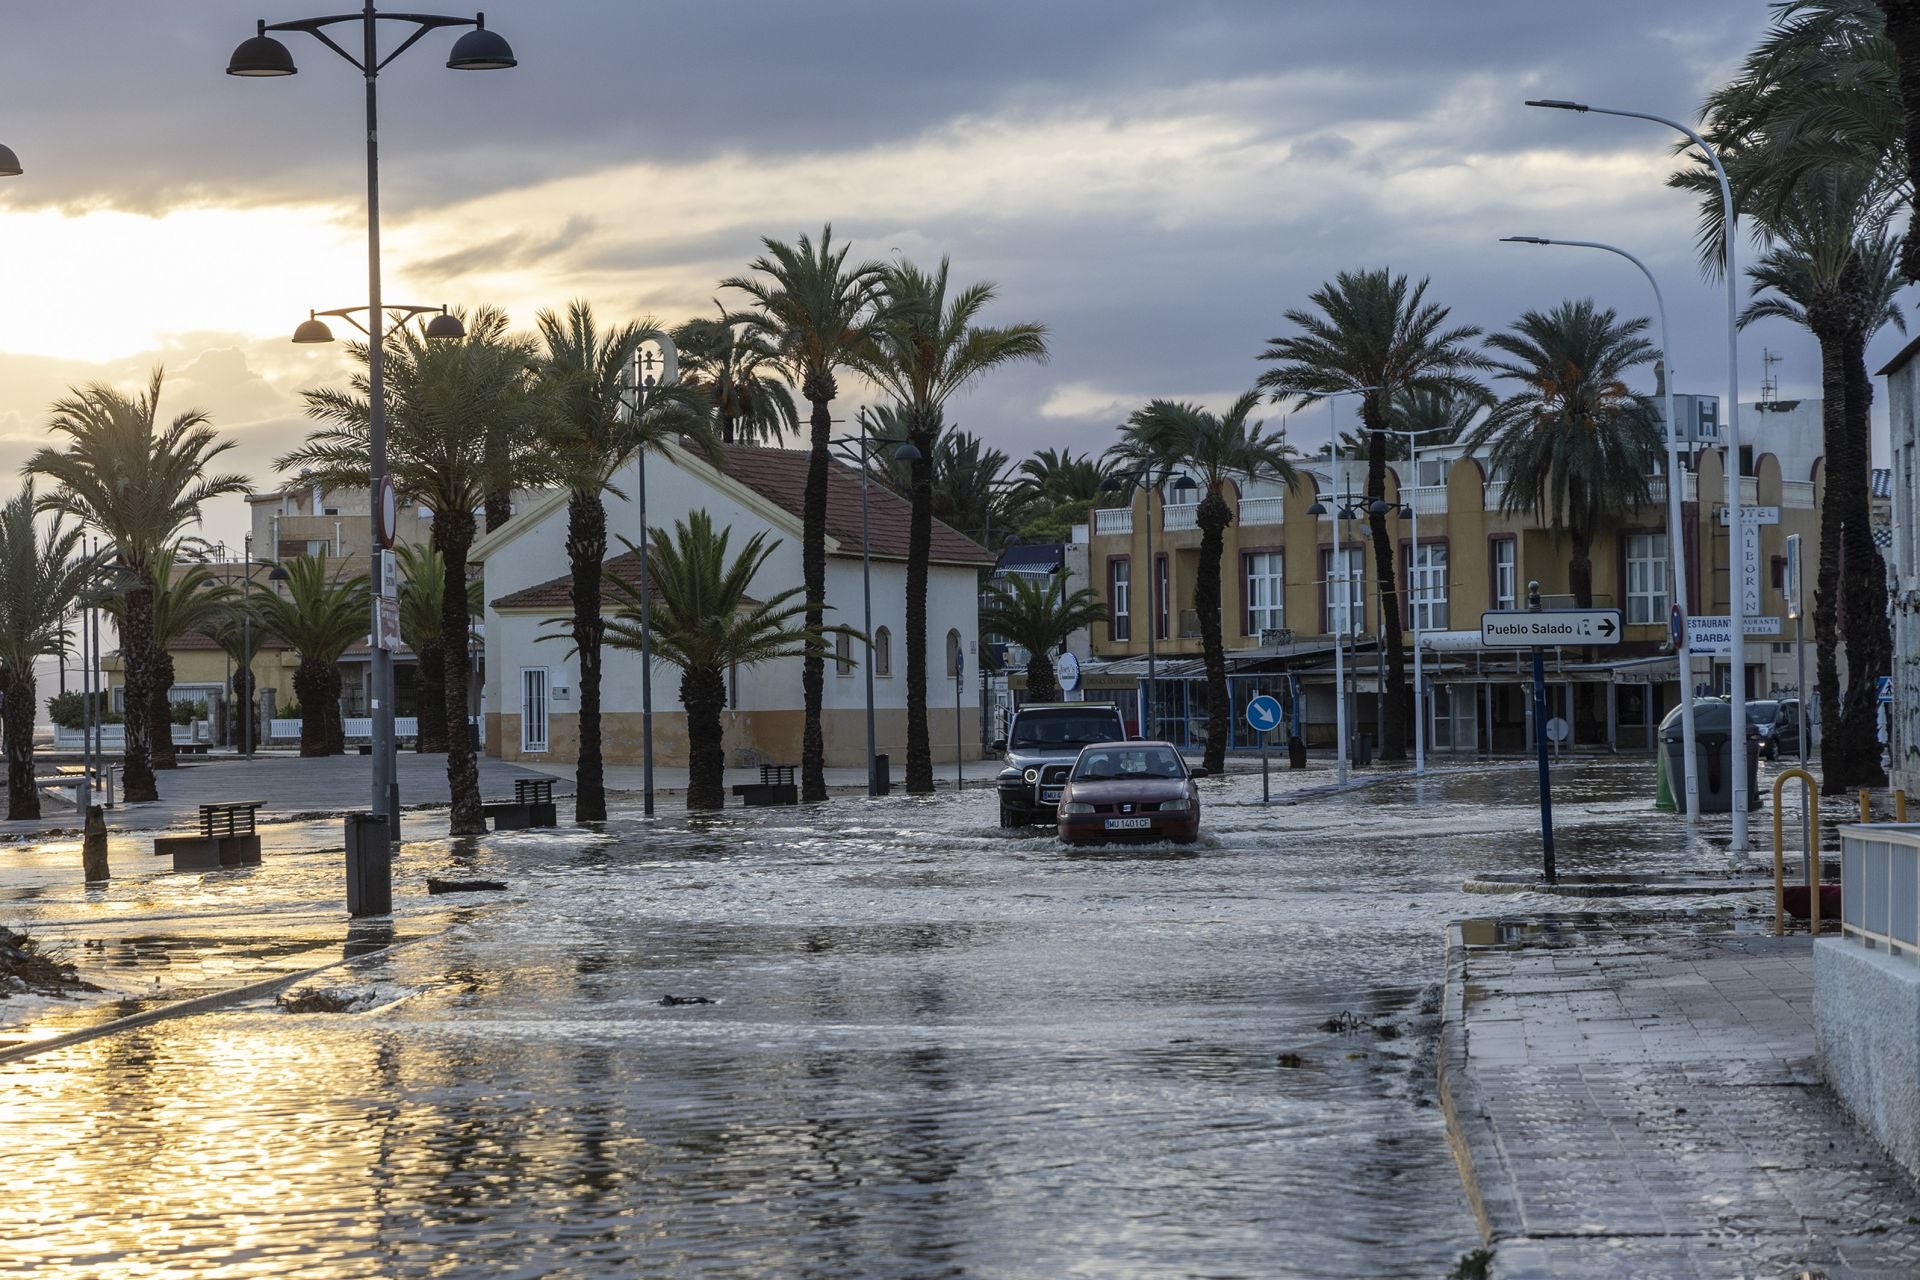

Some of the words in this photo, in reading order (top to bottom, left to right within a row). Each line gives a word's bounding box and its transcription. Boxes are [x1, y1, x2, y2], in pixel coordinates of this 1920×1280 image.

[1745, 527, 1756, 611] ALBORAN
[1487, 623, 1528, 635] Pueblo
[1532, 623, 1573, 635] Salado
[1688, 618, 1732, 629] ESTAURANT
[1696, 633, 1732, 643] BARBA
